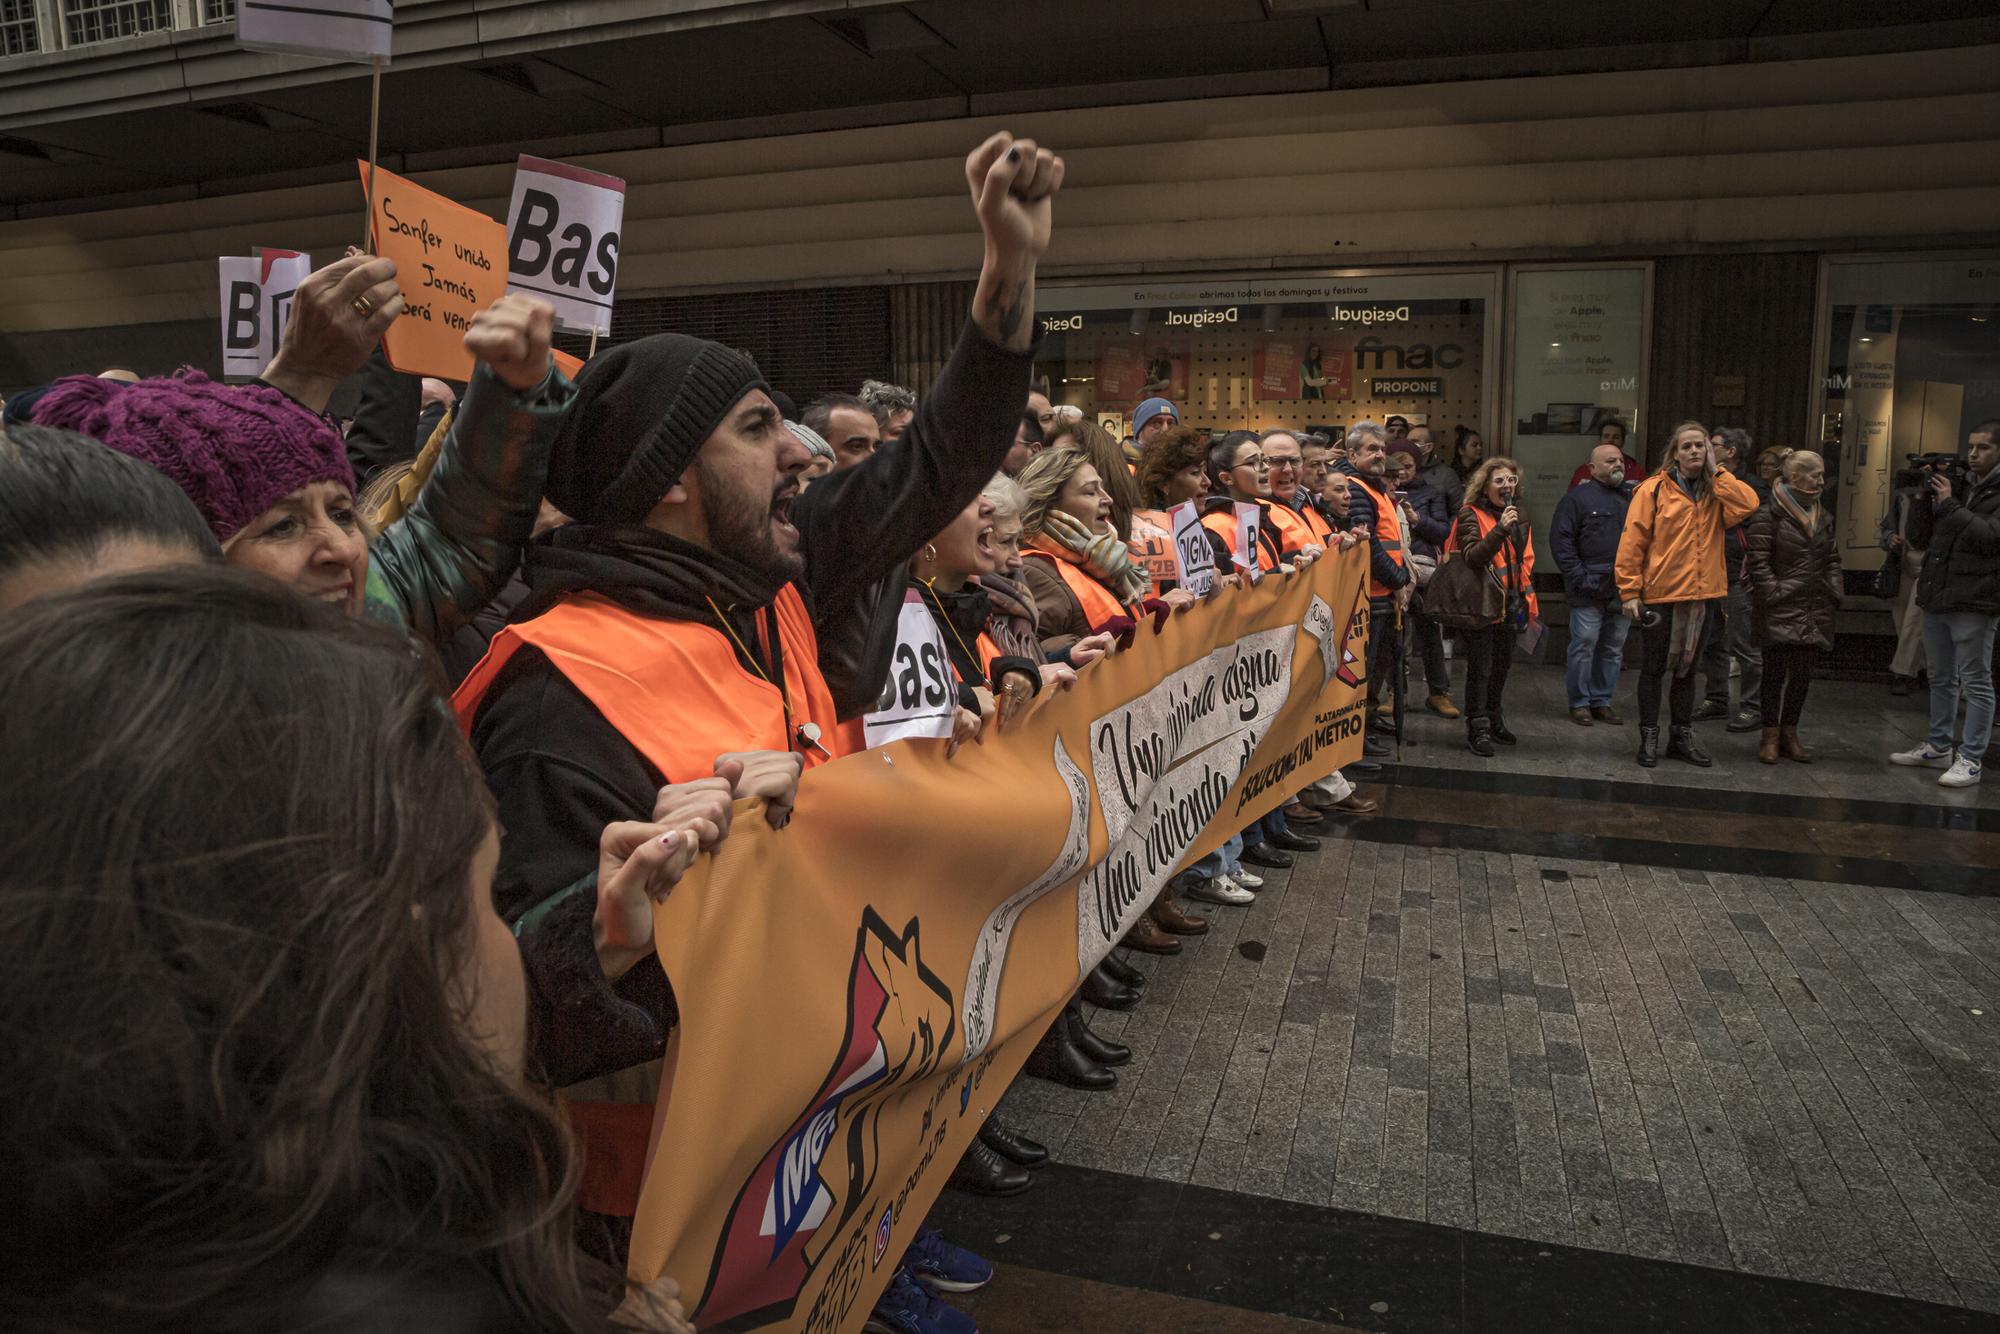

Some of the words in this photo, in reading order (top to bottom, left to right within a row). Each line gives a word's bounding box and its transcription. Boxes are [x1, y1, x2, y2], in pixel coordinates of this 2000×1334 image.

[383, 197, 442, 254] Sanfer
[455, 243, 491, 270] unido
[422, 263, 476, 303] Jamás
[1134, 293, 1145, 301] En
[1199, 291, 1234, 299] abrimos
[1237, 289, 1261, 298] todos
[1264, 288, 1276, 297] los
[1279, 287, 1321, 299] domingos
[1324, 289, 1330, 298] y
[1333, 286, 1368, 296] festivos
[1354, 336, 1464, 369] fnac
[1374, 381, 1438, 393] PROPONE
[1222, 645, 1281, 721] digna
[1315, 714, 1362, 751] METRO
[1085, 851, 1141, 942] Una
[1146, 763, 1227, 875] vivienda
